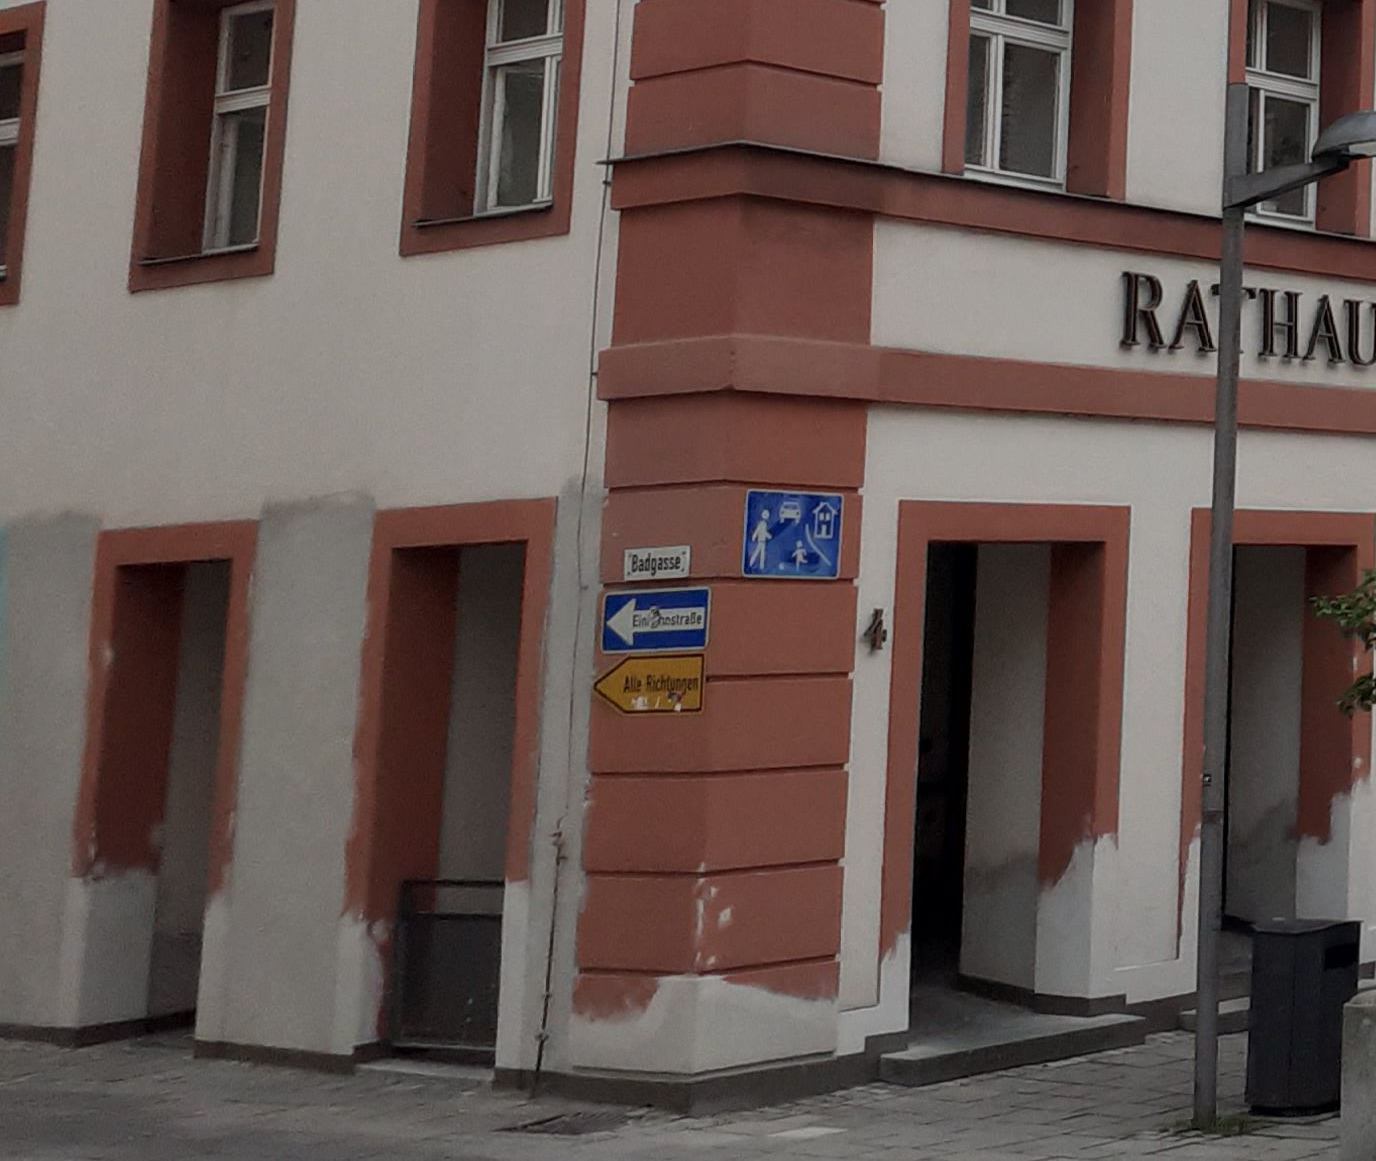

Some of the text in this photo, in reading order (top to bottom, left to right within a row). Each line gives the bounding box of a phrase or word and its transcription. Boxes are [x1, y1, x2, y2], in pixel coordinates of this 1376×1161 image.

[631, 552, 681, 577] Badgasse
[864, 608, 888, 651] 4
[623, 675, 641, 693] Alle
